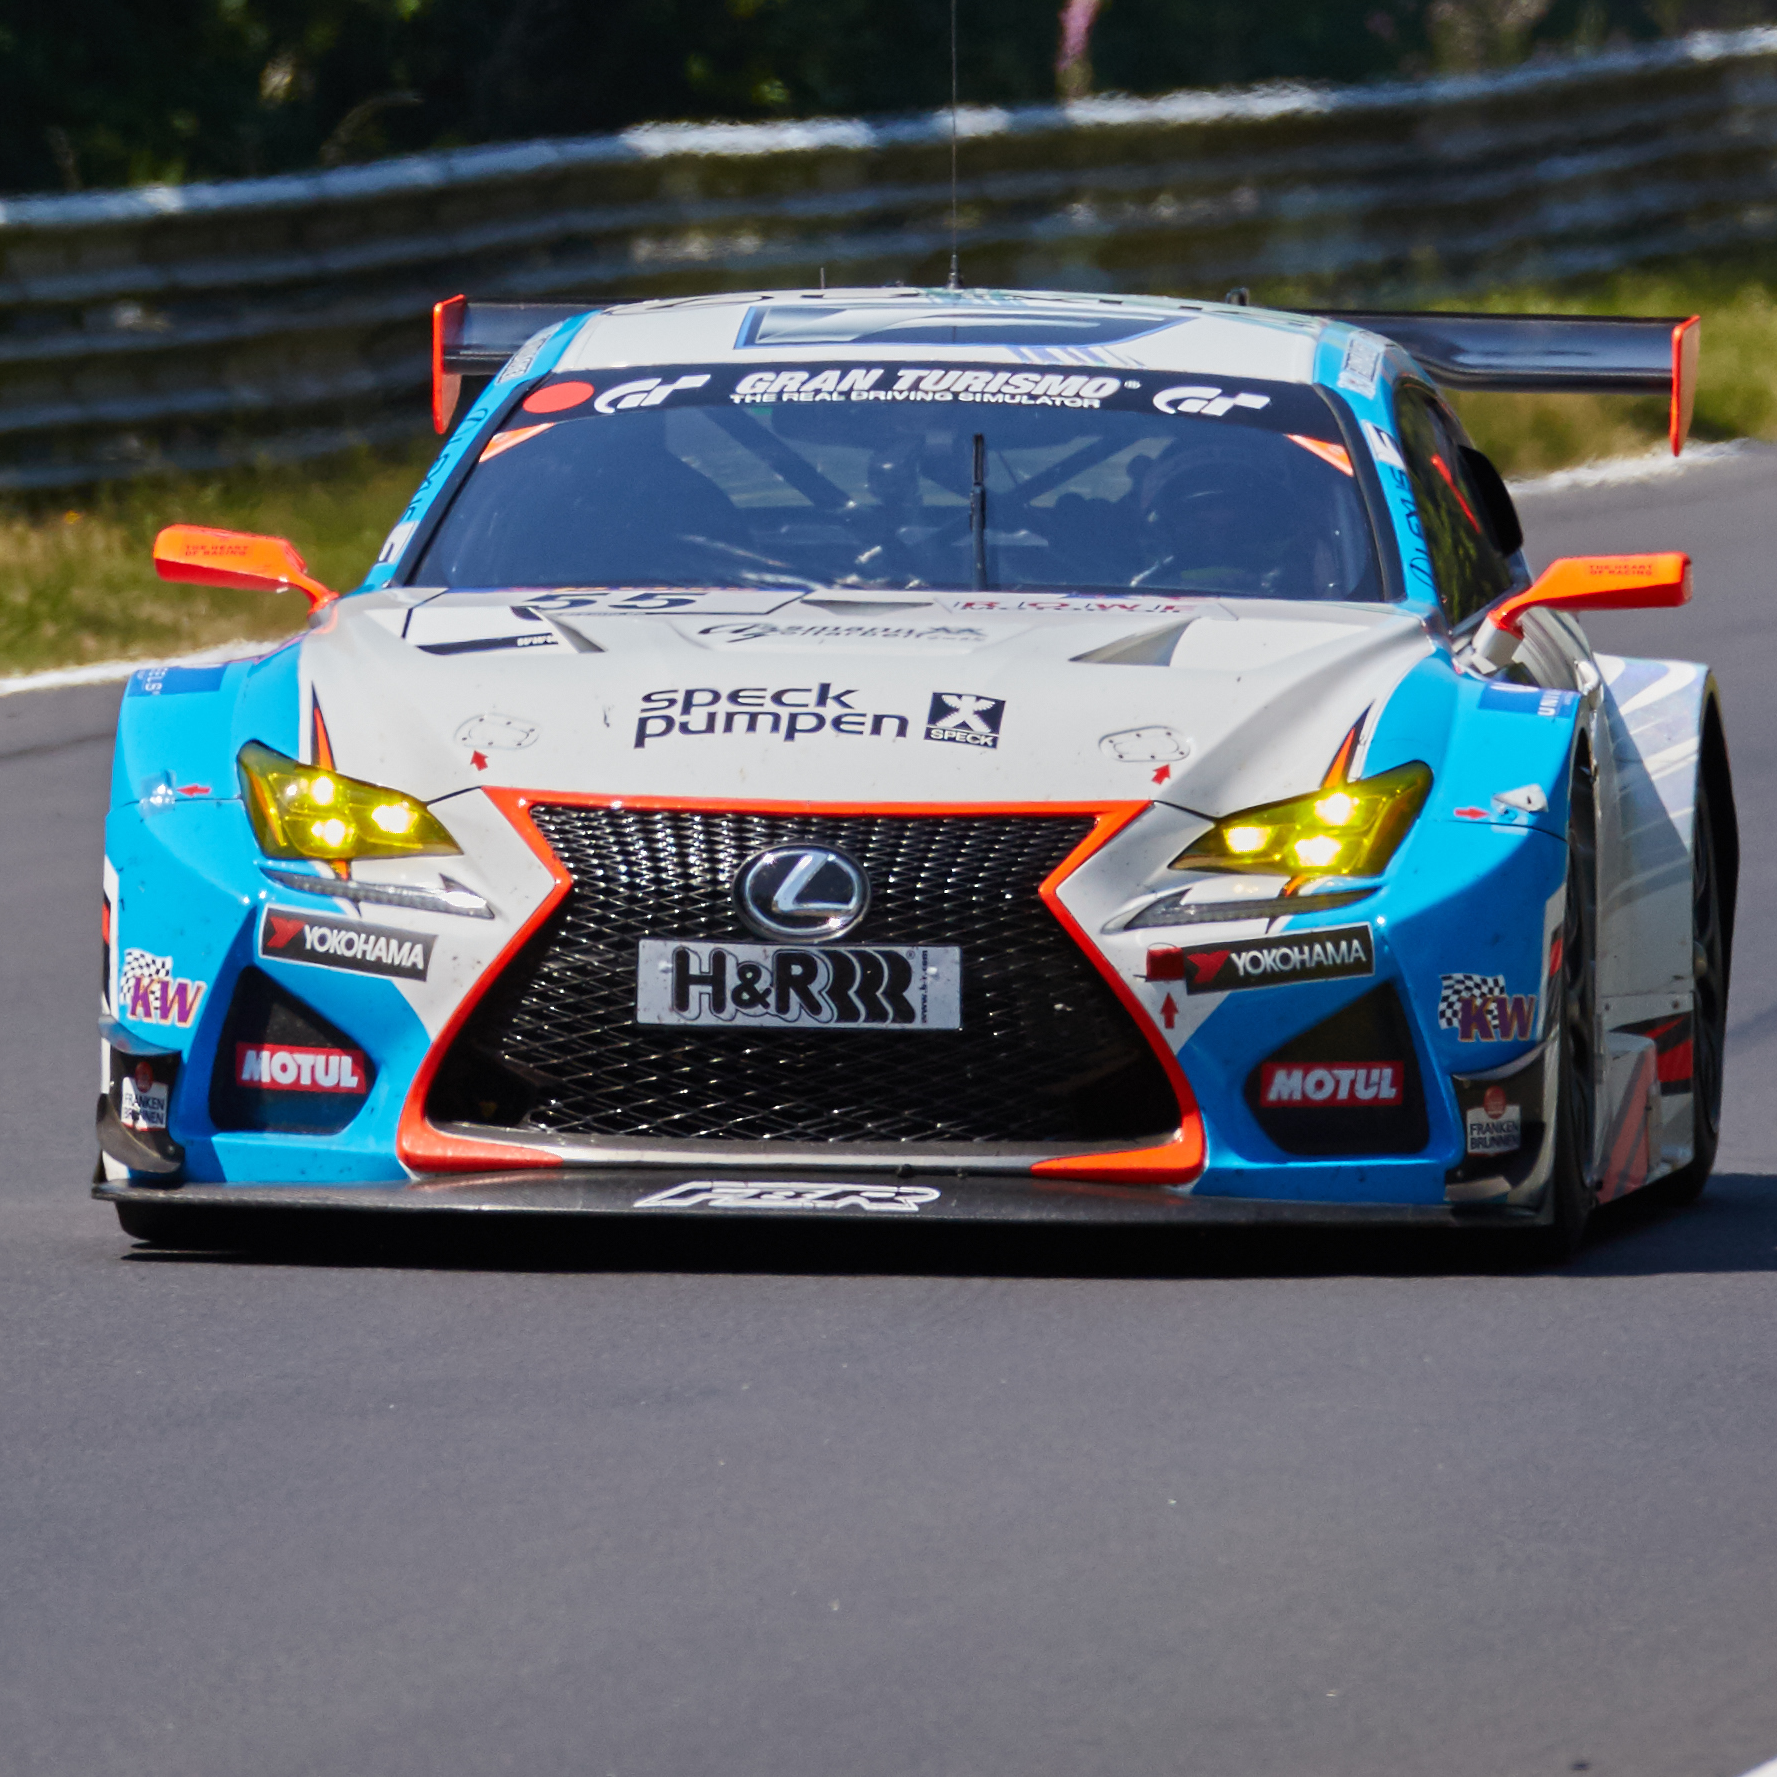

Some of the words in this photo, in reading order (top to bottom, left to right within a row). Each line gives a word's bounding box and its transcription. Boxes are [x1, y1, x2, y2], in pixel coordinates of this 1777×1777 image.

[594, 374, 710, 414] GT
[730, 392, 775, 404] THE
[781, 391, 844, 403] REAL
[856, 390, 953, 402] DRIVING
[958, 391, 1101, 408] SIMULATOR
[735, 369, 885, 394] GRAN
[897, 368, 1120, 399] TURISMO
[1153, 386, 1271, 416] GT
[523, 593, 709, 610] 55
[633, 709, 909, 749] pumpen
[930, 728, 996, 747] SPECK
[303, 924, 424, 970] YOKOHAMA
[1230, 939, 1366, 977] YOKOHAMA
[127, 976, 206, 1028] KW
[1458, 994, 1536, 1043] KW
[241, 1049, 359, 1088] MOTUL
[1267, 1066, 1398, 1101] MOTUL
[1470, 1120, 1519, 1136] FRANKEN
[1470, 1134, 1519, 1150] BRUNNEN
